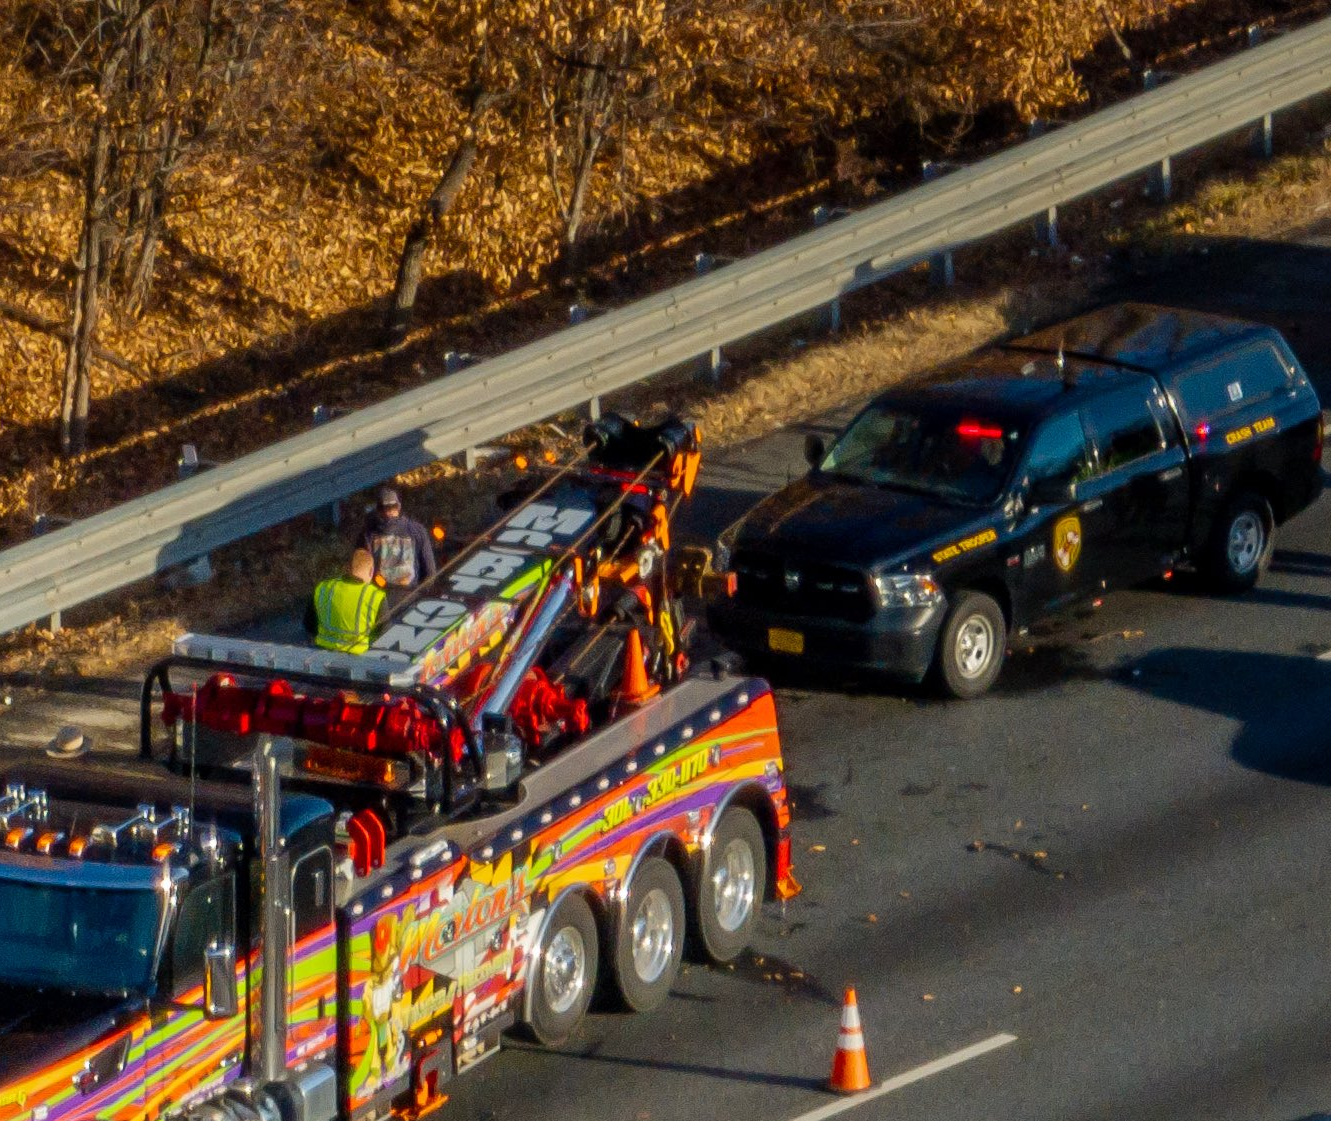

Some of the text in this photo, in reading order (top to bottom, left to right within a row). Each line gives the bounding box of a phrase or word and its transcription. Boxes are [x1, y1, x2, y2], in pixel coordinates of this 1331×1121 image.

[1225, 416, 1276, 446] CRASH TEAM
[932, 528, 998, 564] STATE TROOPER
